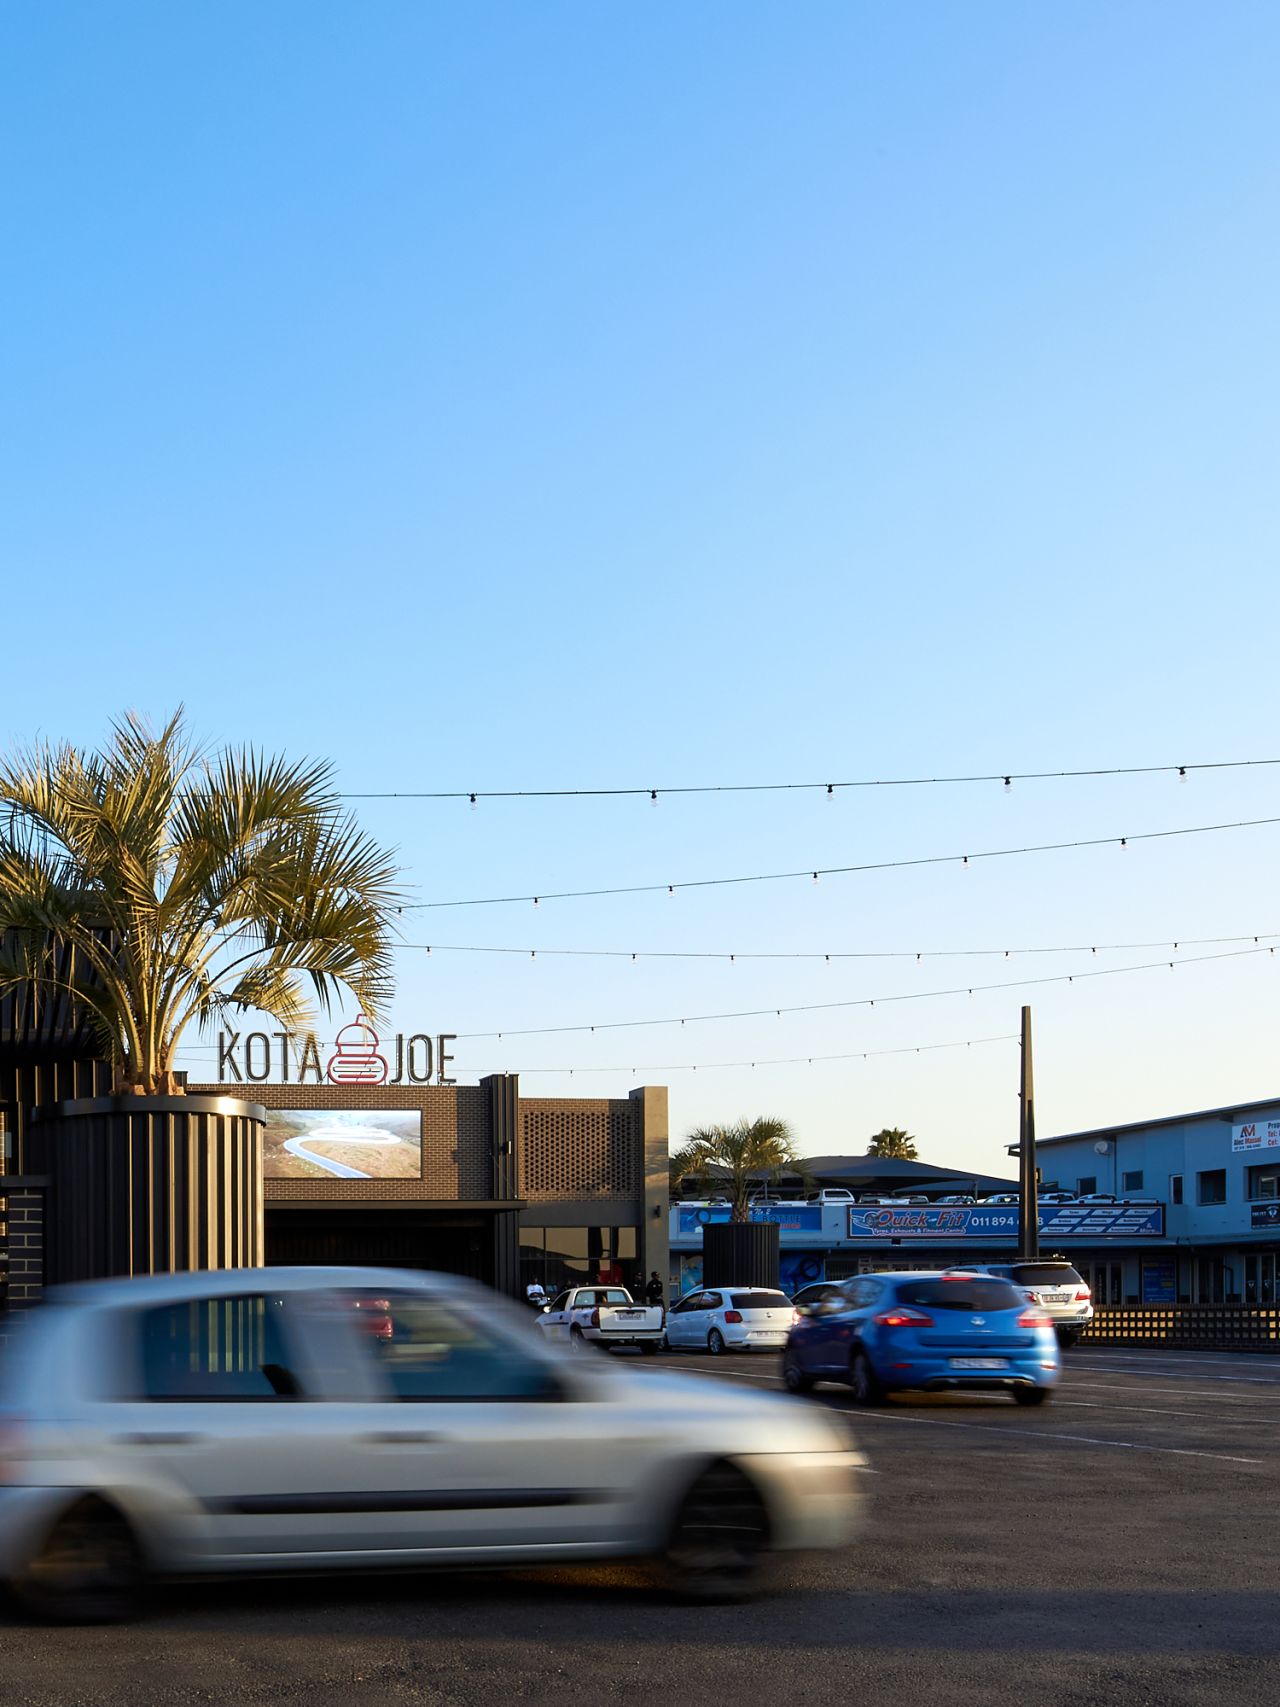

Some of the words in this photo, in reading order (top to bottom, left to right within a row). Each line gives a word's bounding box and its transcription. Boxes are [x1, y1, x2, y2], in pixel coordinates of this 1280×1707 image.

[217, 1031, 323, 1083] KOTA
[389, 1033, 458, 1084] JOE
[971, 1216, 990, 1226] 011
[991, 1216, 1015, 1226] 894
